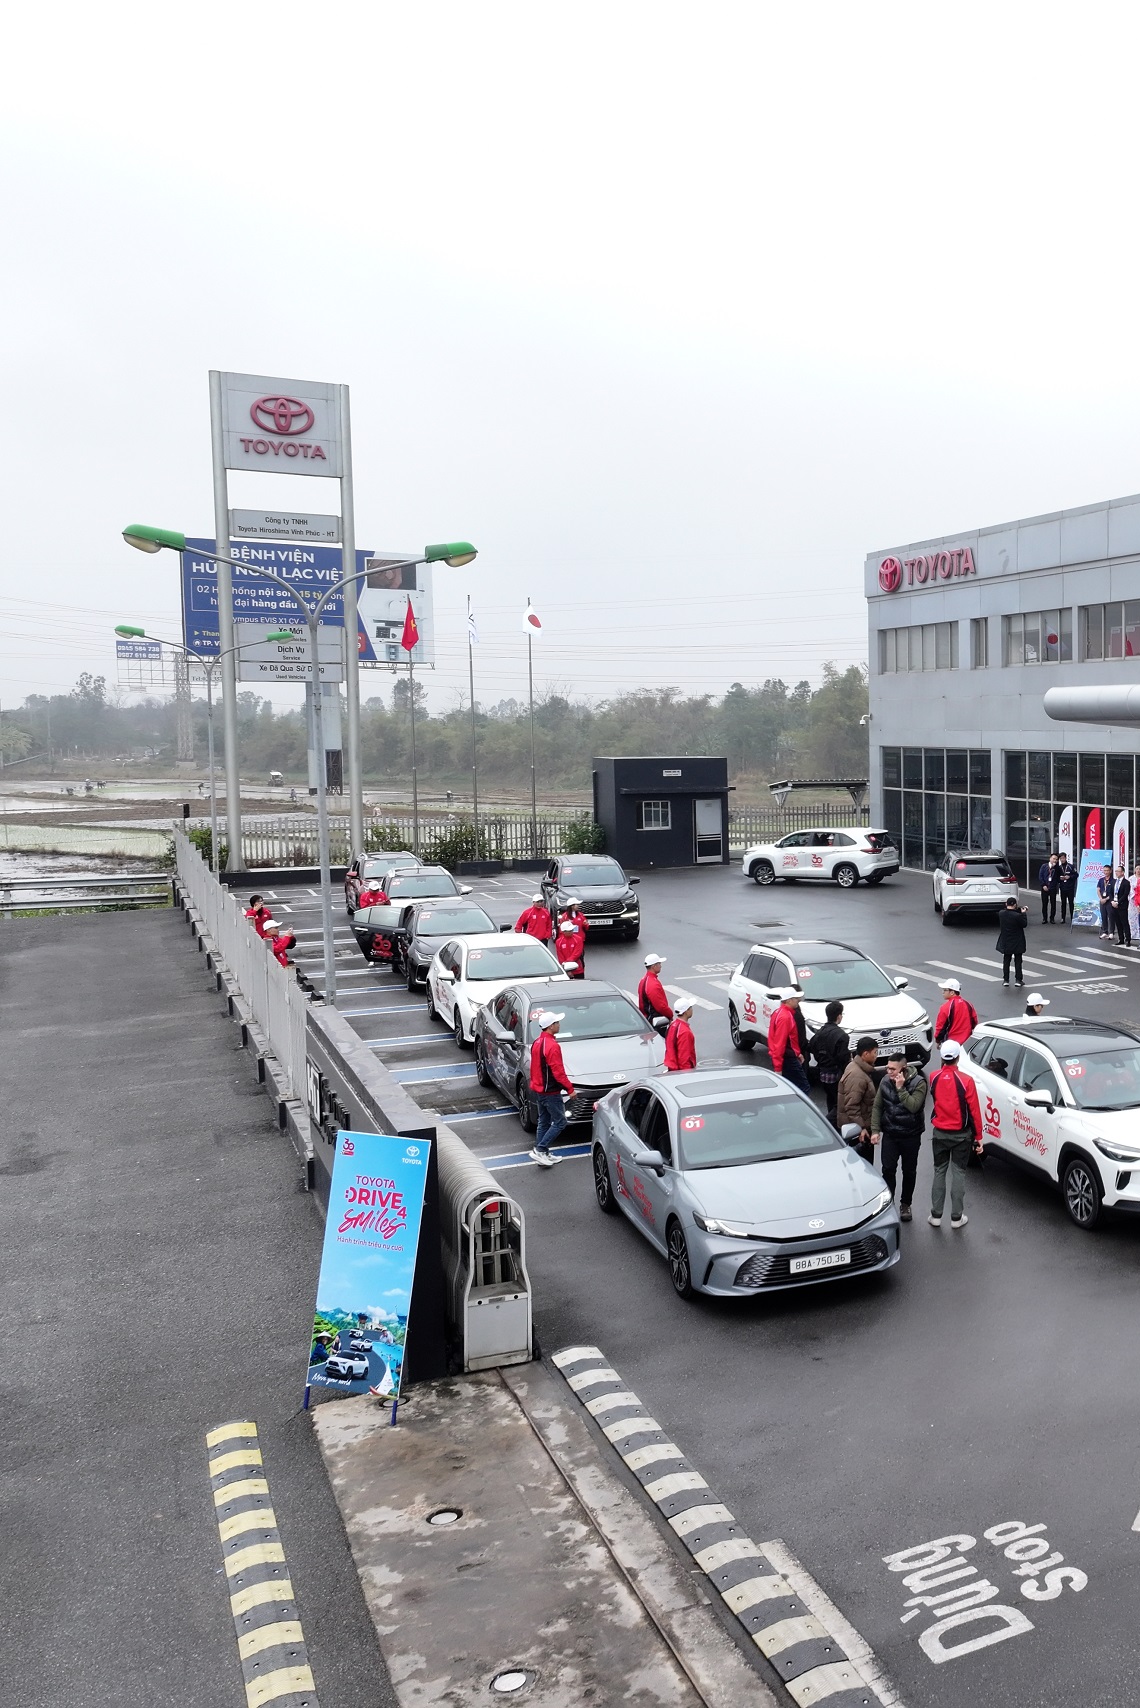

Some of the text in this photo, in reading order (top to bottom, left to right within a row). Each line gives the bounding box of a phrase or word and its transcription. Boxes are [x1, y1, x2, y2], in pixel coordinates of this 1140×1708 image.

[240, 438, 327, 460] TOYOTA
[283, 517, 290, 526] ty
[291, 518, 308, 526] TNHH
[237, 526, 258, 534] Toyota
[259, 527, 290, 535] Hiroshima
[230, 545, 315, 564] BỆNH VIỆN
[282, 567, 314, 581] LẠC
[904, 546, 976, 585] TOYOTA
[1068, 1067, 1082, 1076] 07
[985, 1095, 1001, 1127] 30
[685, 1119, 701, 1129] 01
[401, 1157, 422, 1166] TOYOTA
[356, 1175, 396, 1190] TOYOTA
[345, 1186, 404, 1210] DRIVE
[983, 1521, 1089, 1601] Stop
[882, 1534, 1036, 1665] Dừng
